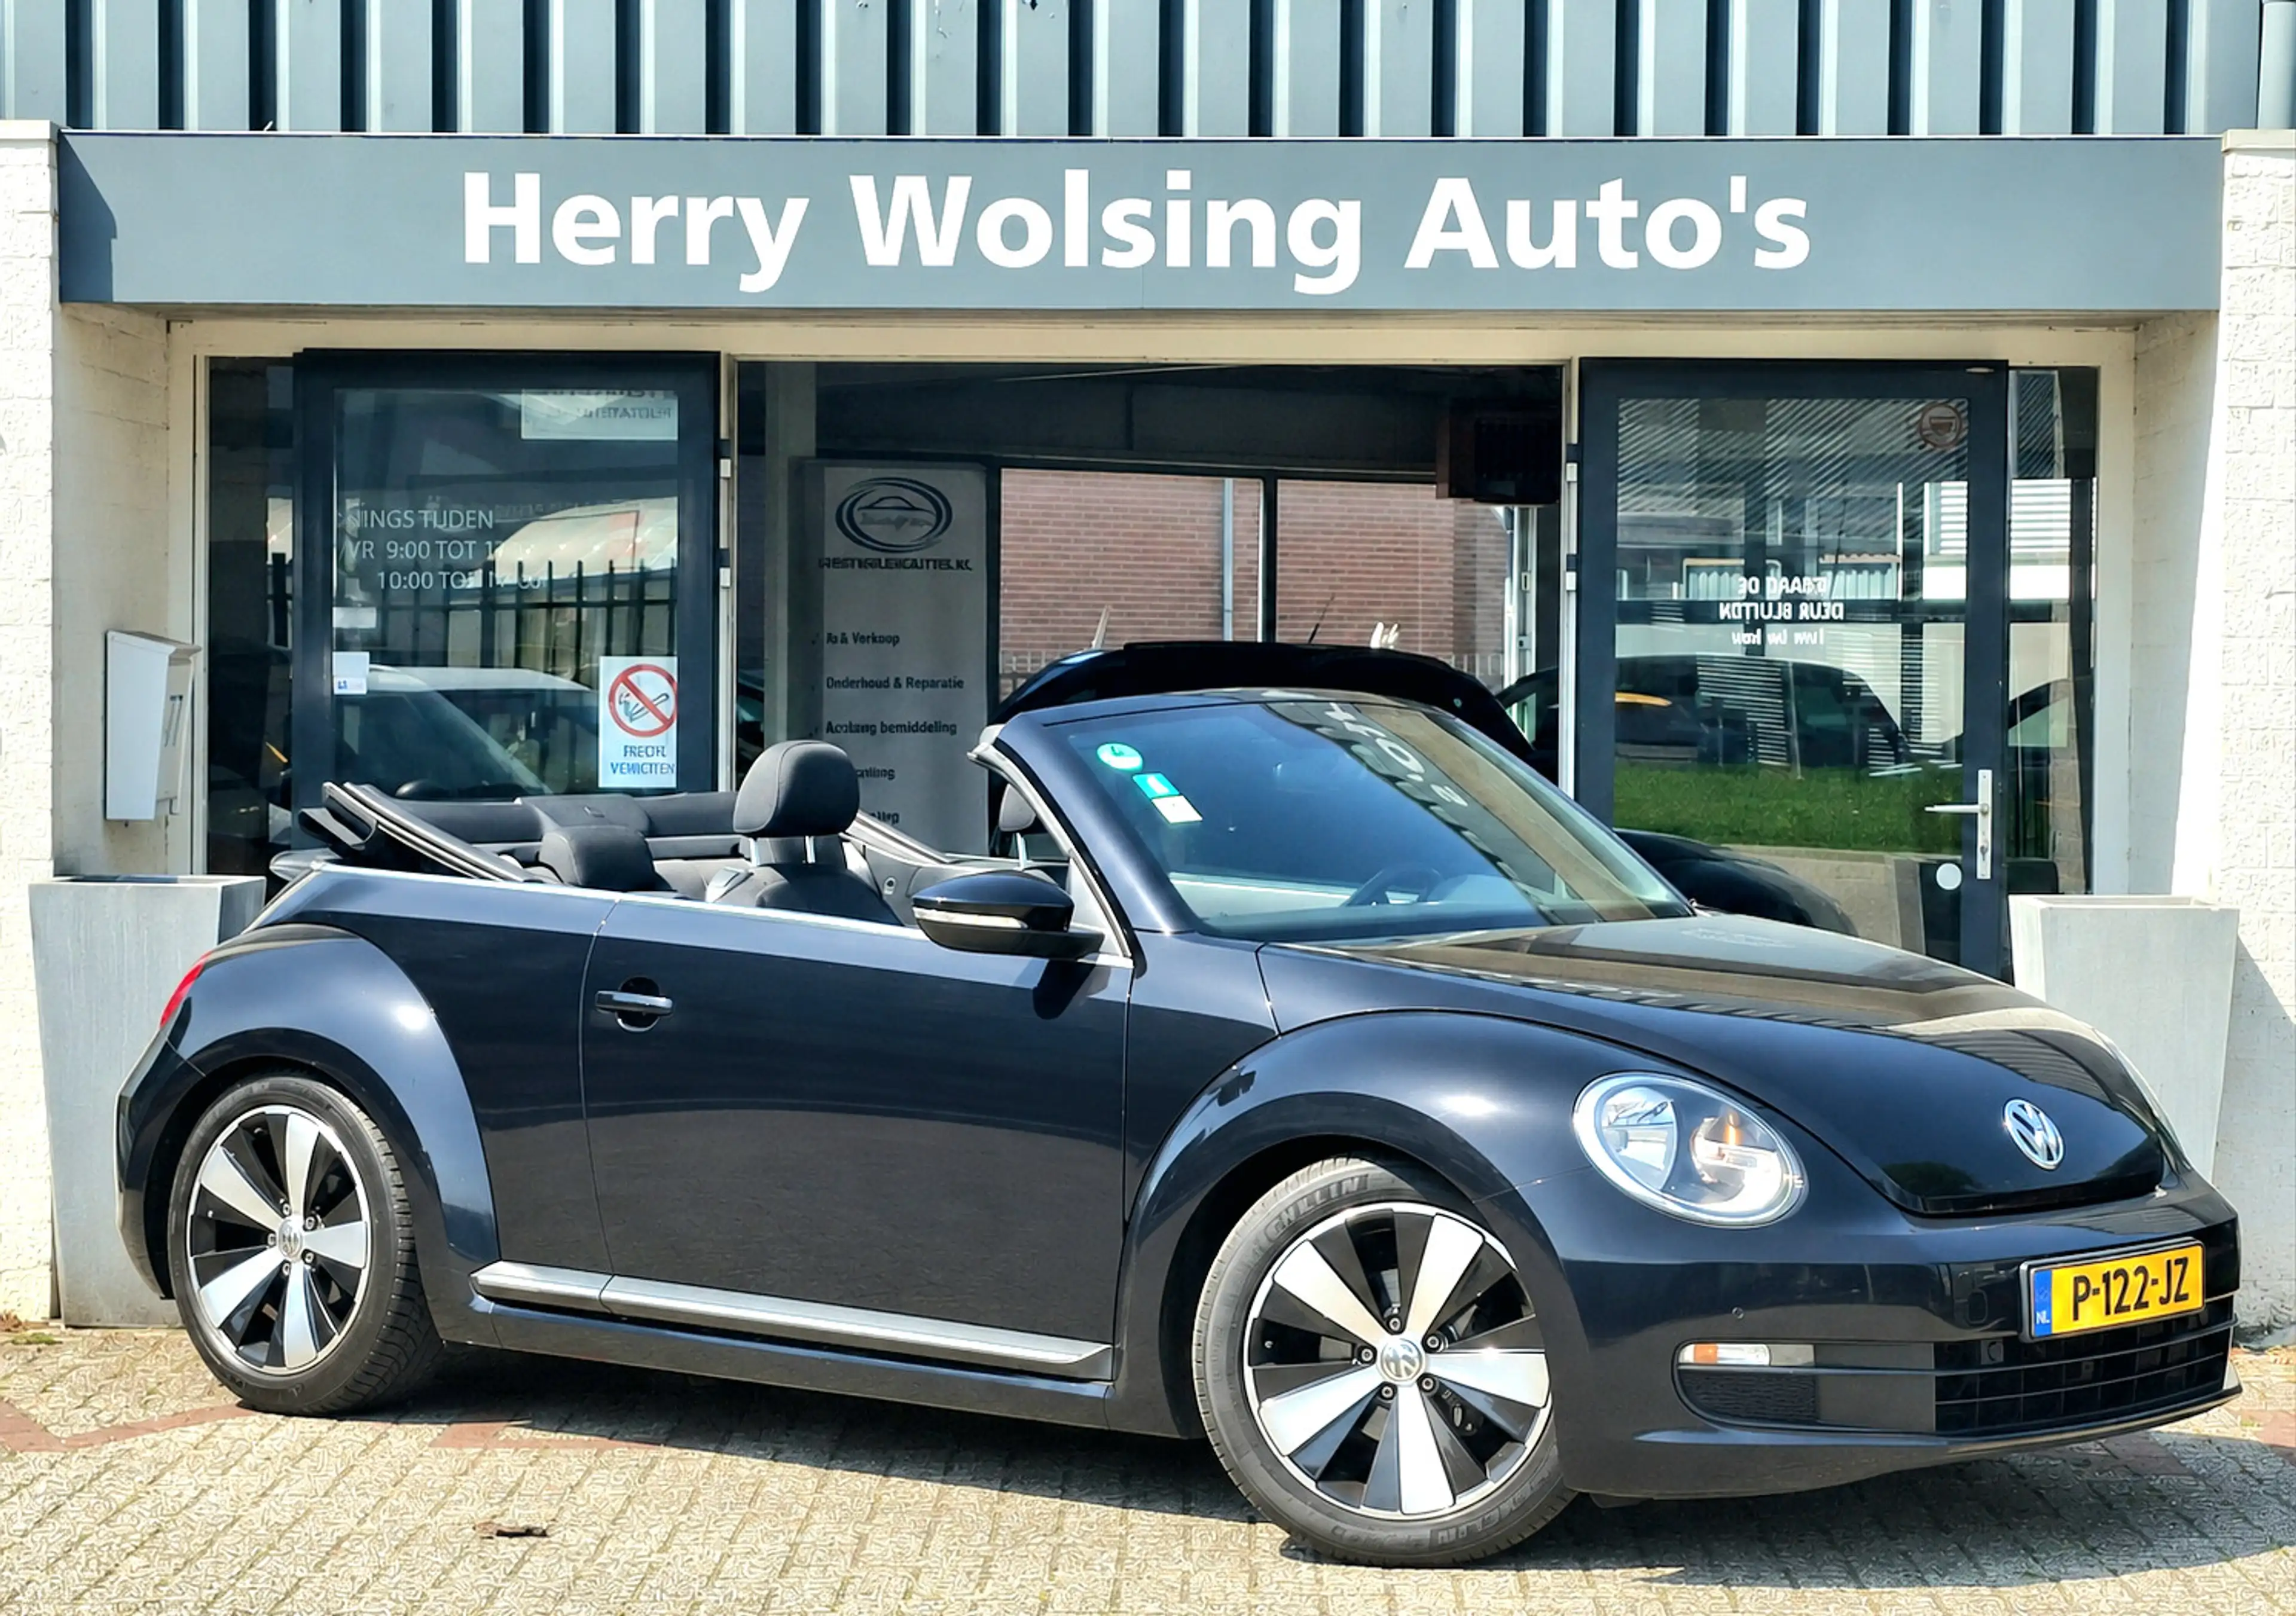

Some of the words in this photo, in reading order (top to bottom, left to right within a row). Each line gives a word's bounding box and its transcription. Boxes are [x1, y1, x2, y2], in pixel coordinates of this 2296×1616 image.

[463, 172, 810, 293] Herry
[848, 168, 1361, 295] Wolsing
[1404, 175, 1810, 269] Auto's
[386, 540, 430, 560] 9:00
[435, 540, 477, 560] TOT
[378, 572, 434, 590] 10:00
[852, 631, 900, 647] Verkoop
[826, 676, 890, 689] Onderhoud
[906, 676, 964, 692] Reparatie
[880, 720, 957, 736] bemiddeling
[2035, 1310, 2051, 1325] NL
[2072, 1257, 2190, 1322] P-122-JZ
